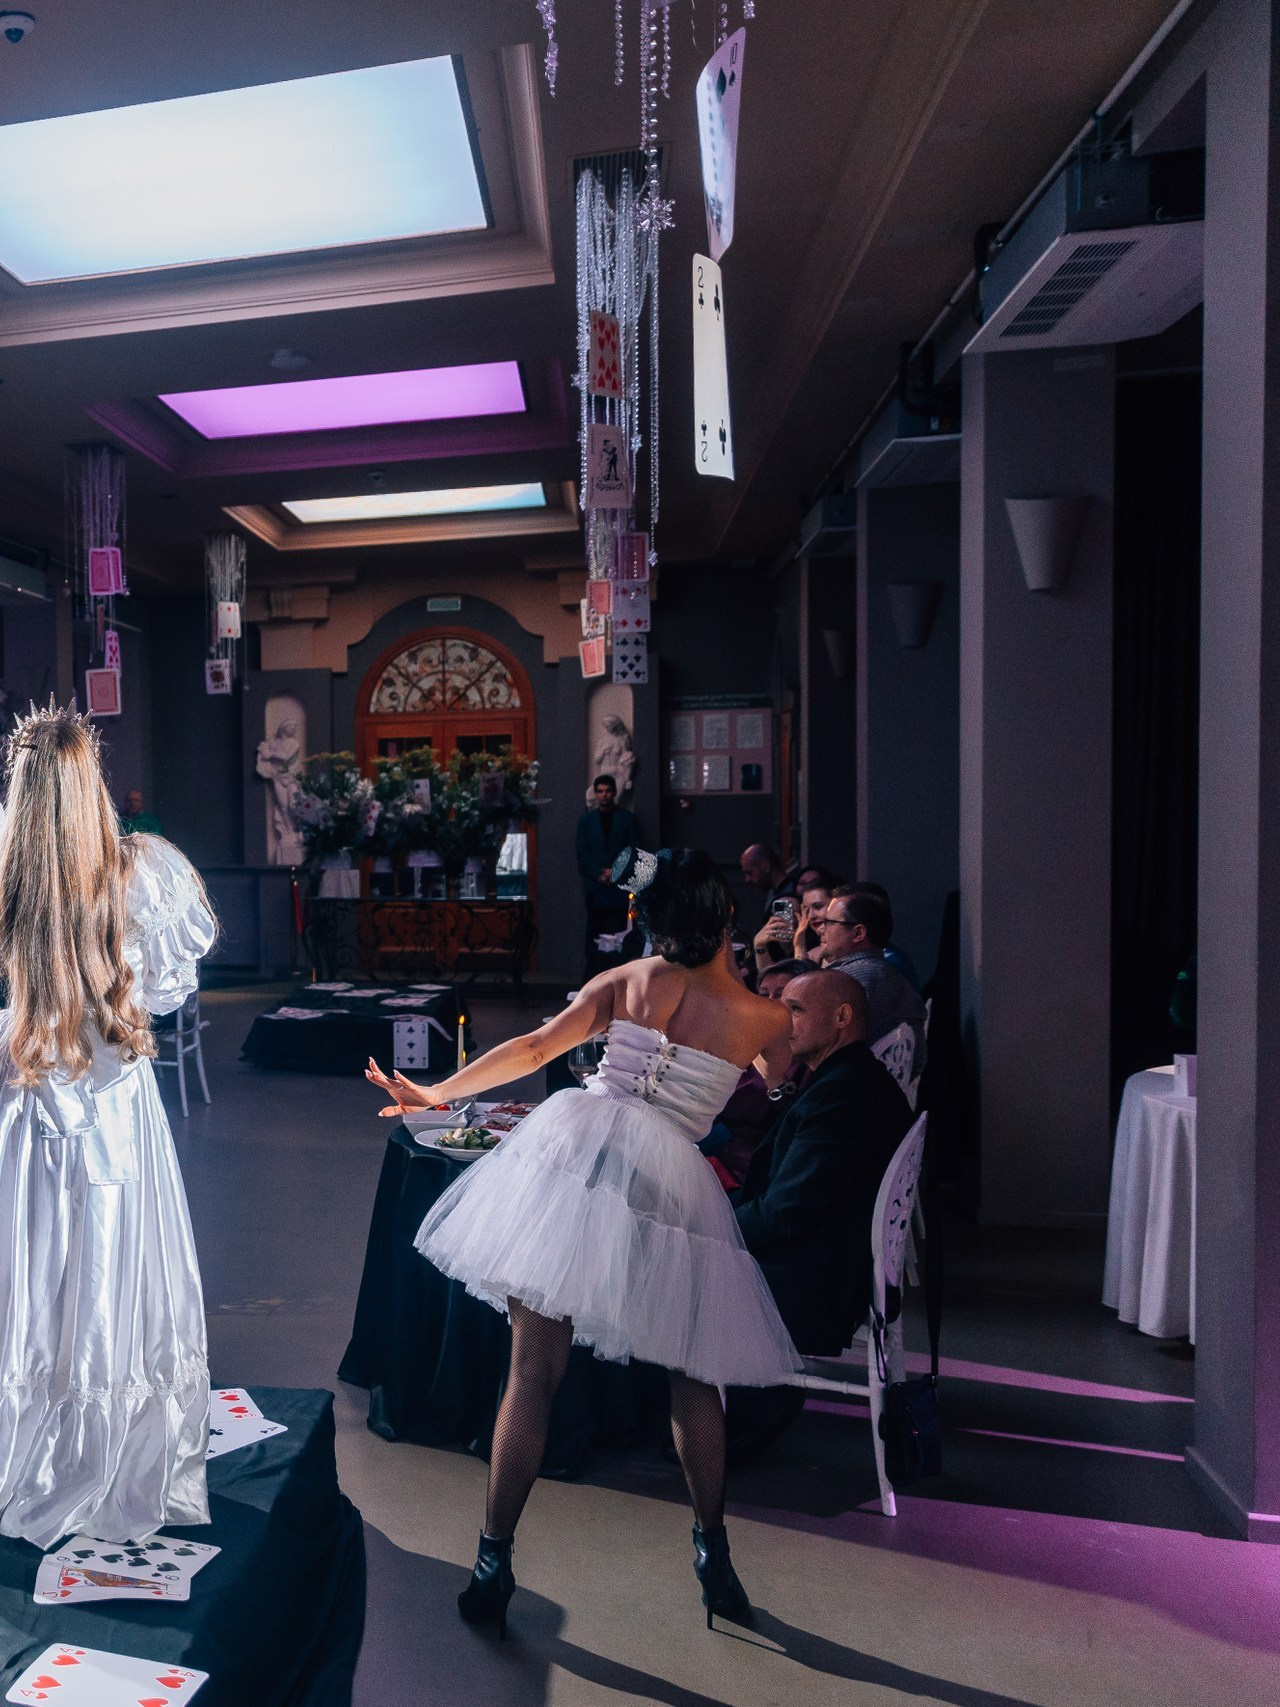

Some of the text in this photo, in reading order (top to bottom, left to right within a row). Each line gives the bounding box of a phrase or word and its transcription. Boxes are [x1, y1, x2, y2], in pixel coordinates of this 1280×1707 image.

[730, 42, 738, 67] 10
[697, 266, 704, 288] 2
[700, 441, 708, 463] 2
[19, 1689, 35, 1697] 4
